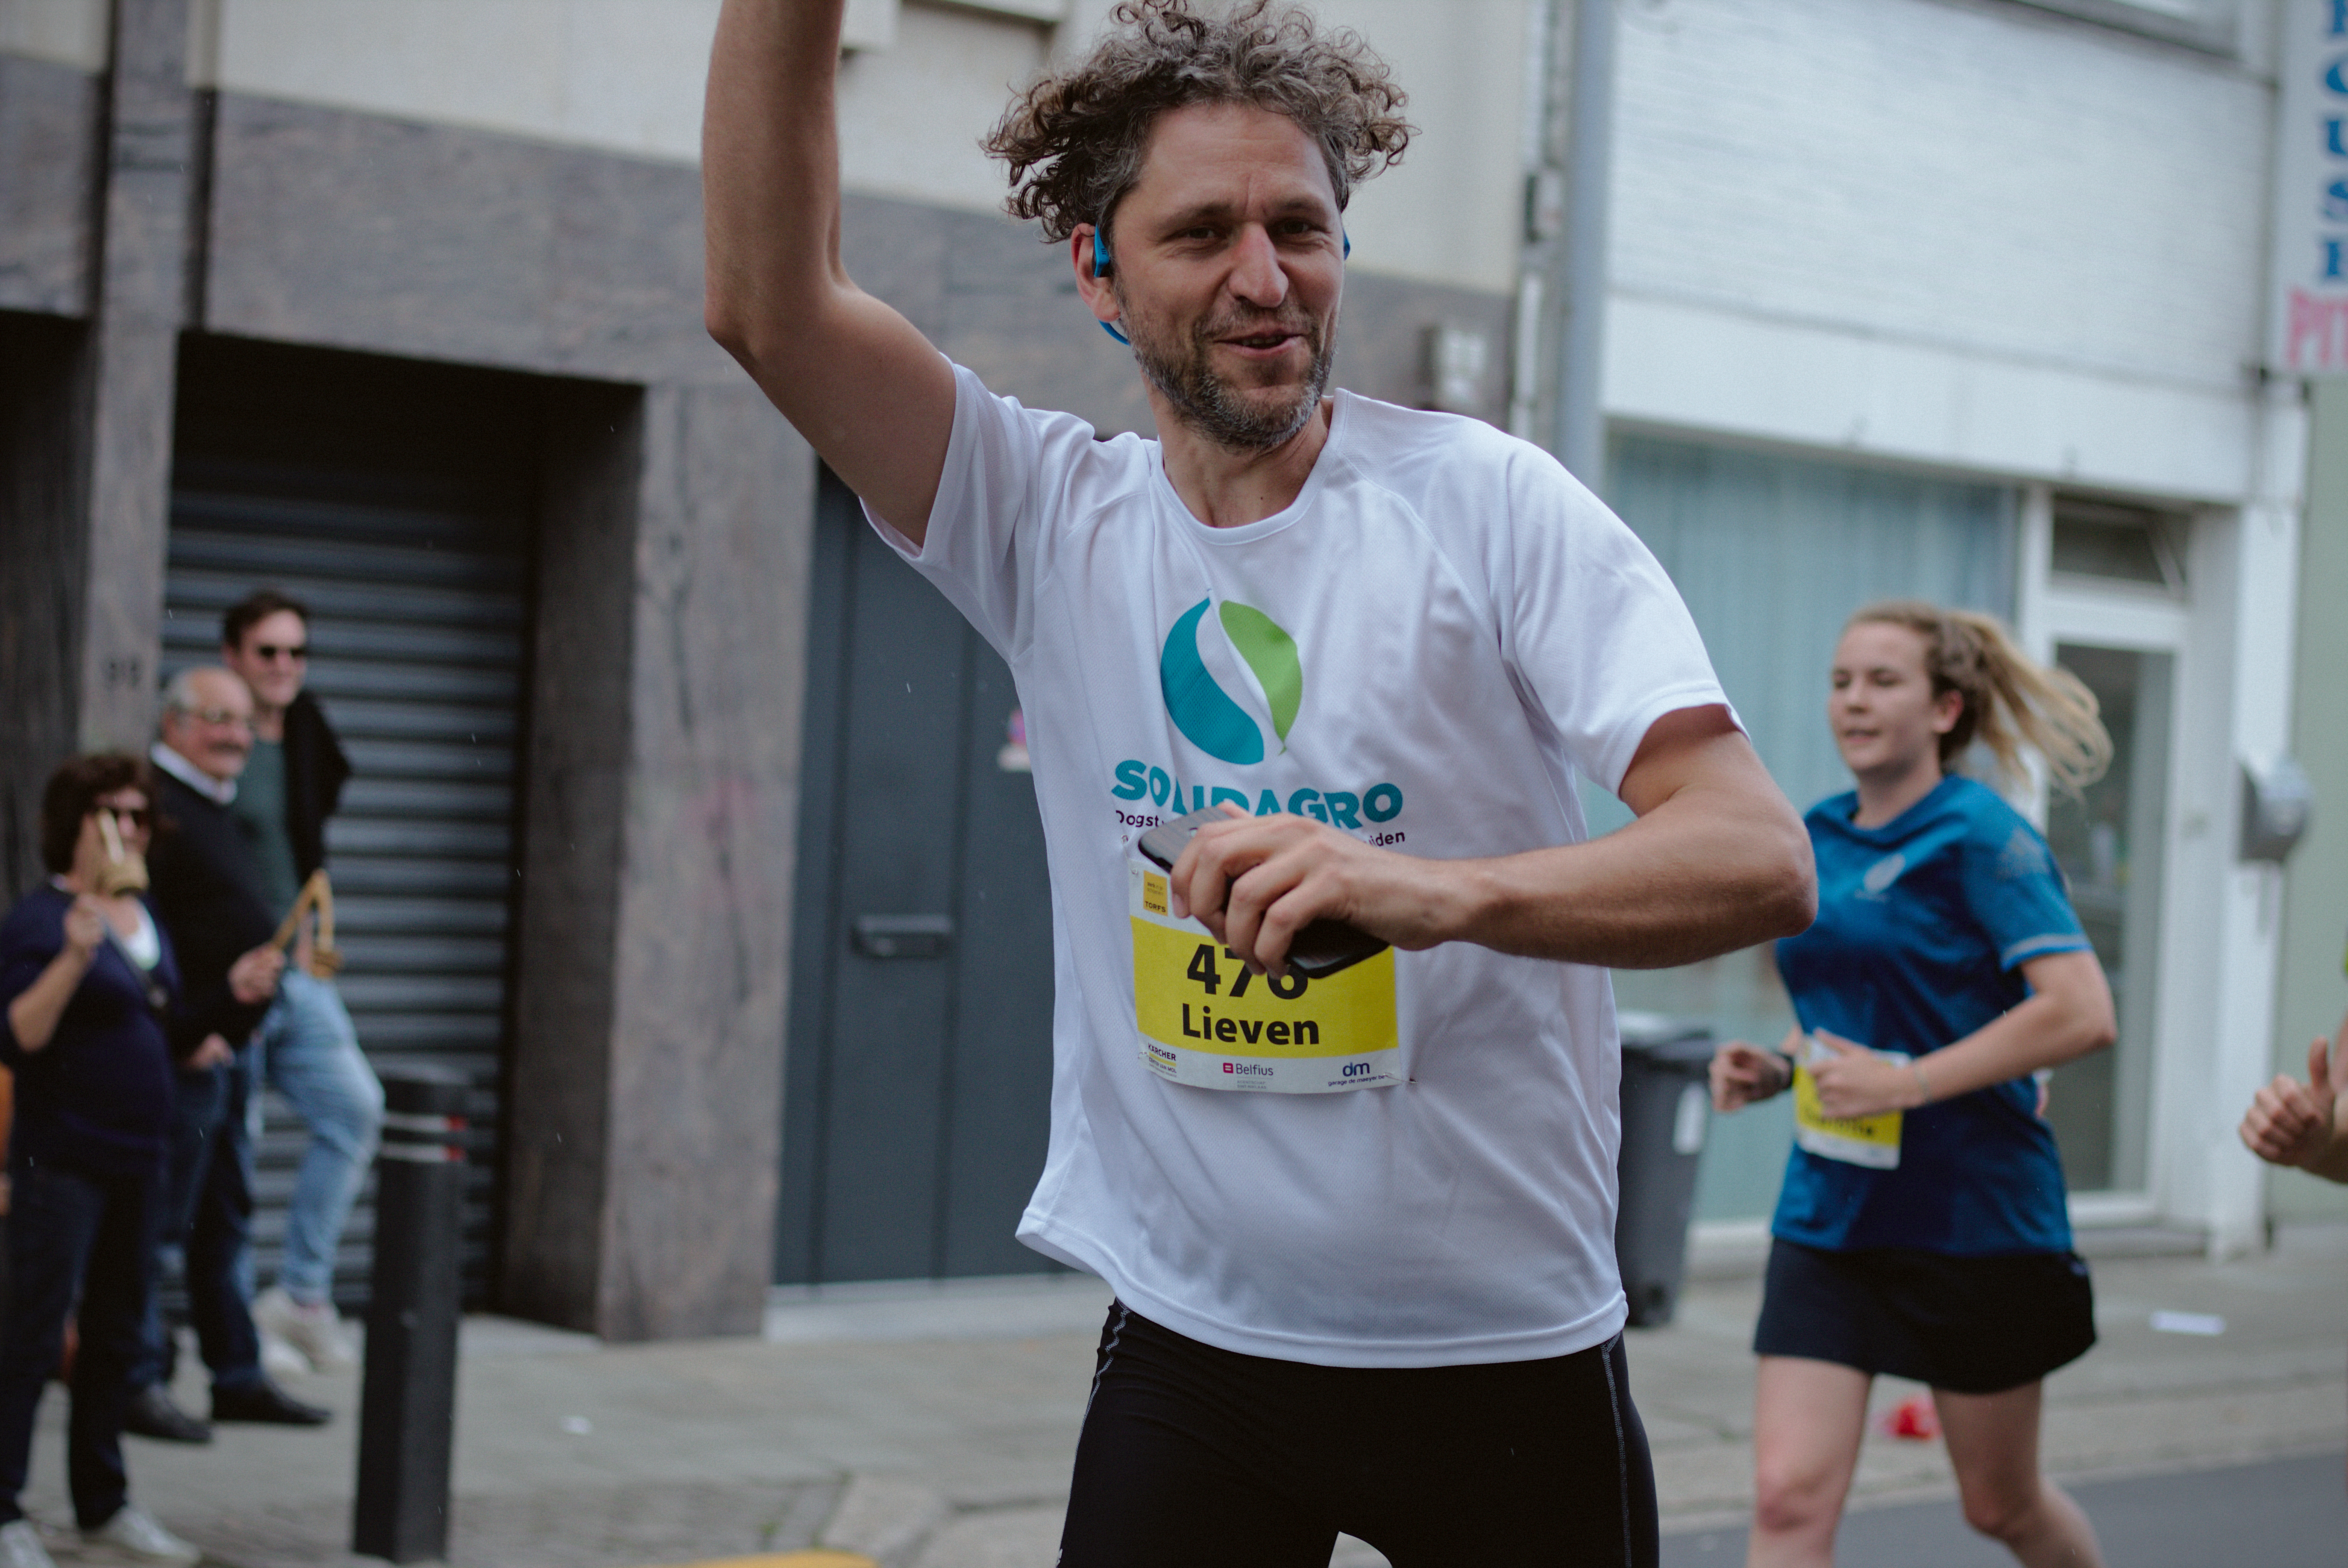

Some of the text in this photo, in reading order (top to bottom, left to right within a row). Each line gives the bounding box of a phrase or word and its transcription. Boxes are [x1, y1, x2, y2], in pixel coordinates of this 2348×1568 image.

[1145, 900, 1166, 913] TORFS
[1187, 943, 1308, 1000] 476
[1182, 1003, 1320, 1045] Lieven
[1236, 1063, 1274, 1076] Belfius
[1342, 1062, 1370, 1077] dm
